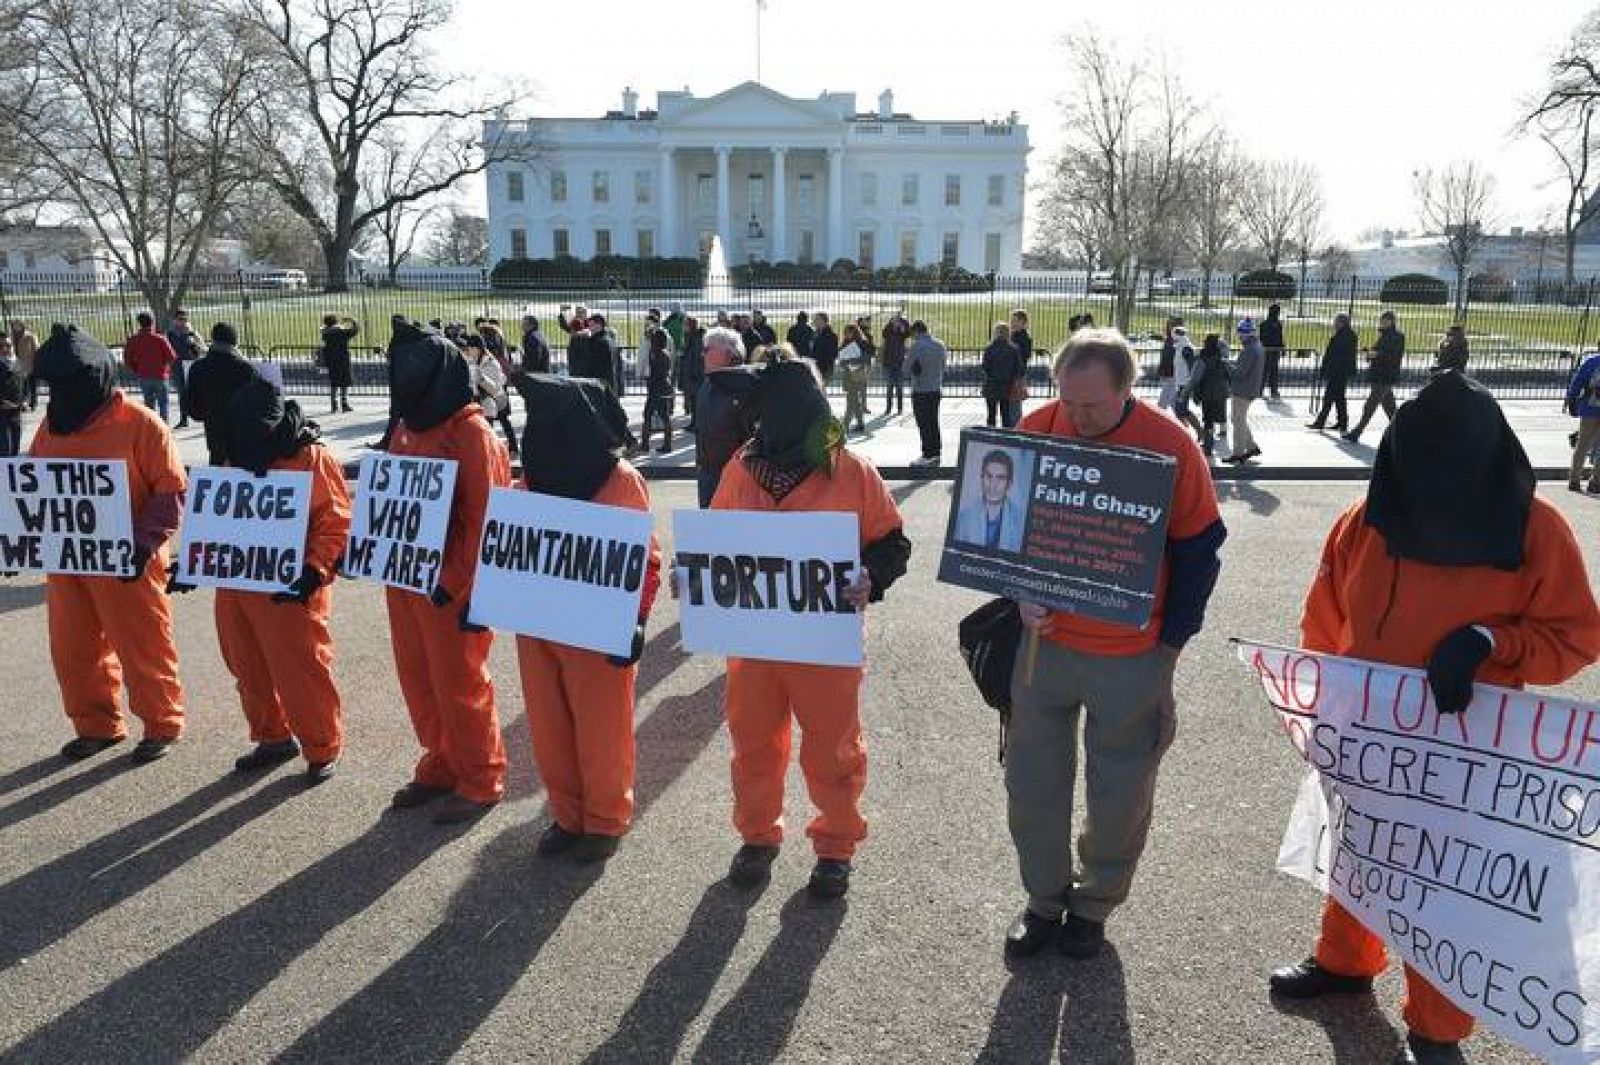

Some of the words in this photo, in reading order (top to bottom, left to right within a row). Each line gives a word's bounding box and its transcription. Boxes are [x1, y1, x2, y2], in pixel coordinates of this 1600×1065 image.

[8, 462, 40, 494] IS
[46, 463, 115, 498] THIS
[368, 459, 392, 492] IS
[398, 460, 444, 501] THIS
[1038, 455, 1101, 483] Free
[16, 498, 97, 534] WHO
[368, 497, 421, 542] WHO
[1034, 483, 1085, 507] Fahd
[1092, 494, 1162, 523] Ghazy
[0, 534, 43, 568] WE
[59, 537, 132, 574] ARE?
[187, 541, 297, 585] FEEDING
[348, 536, 379, 576] WE
[382, 541, 441, 594] ARE?
[479, 519, 646, 593] GUANTANAMO
[675, 551, 857, 615] TORTURE
[1252, 650, 1321, 710] NO
[1313, 723, 1487, 806] SECRET
[1386, 908, 1588, 1047] PROCESS
